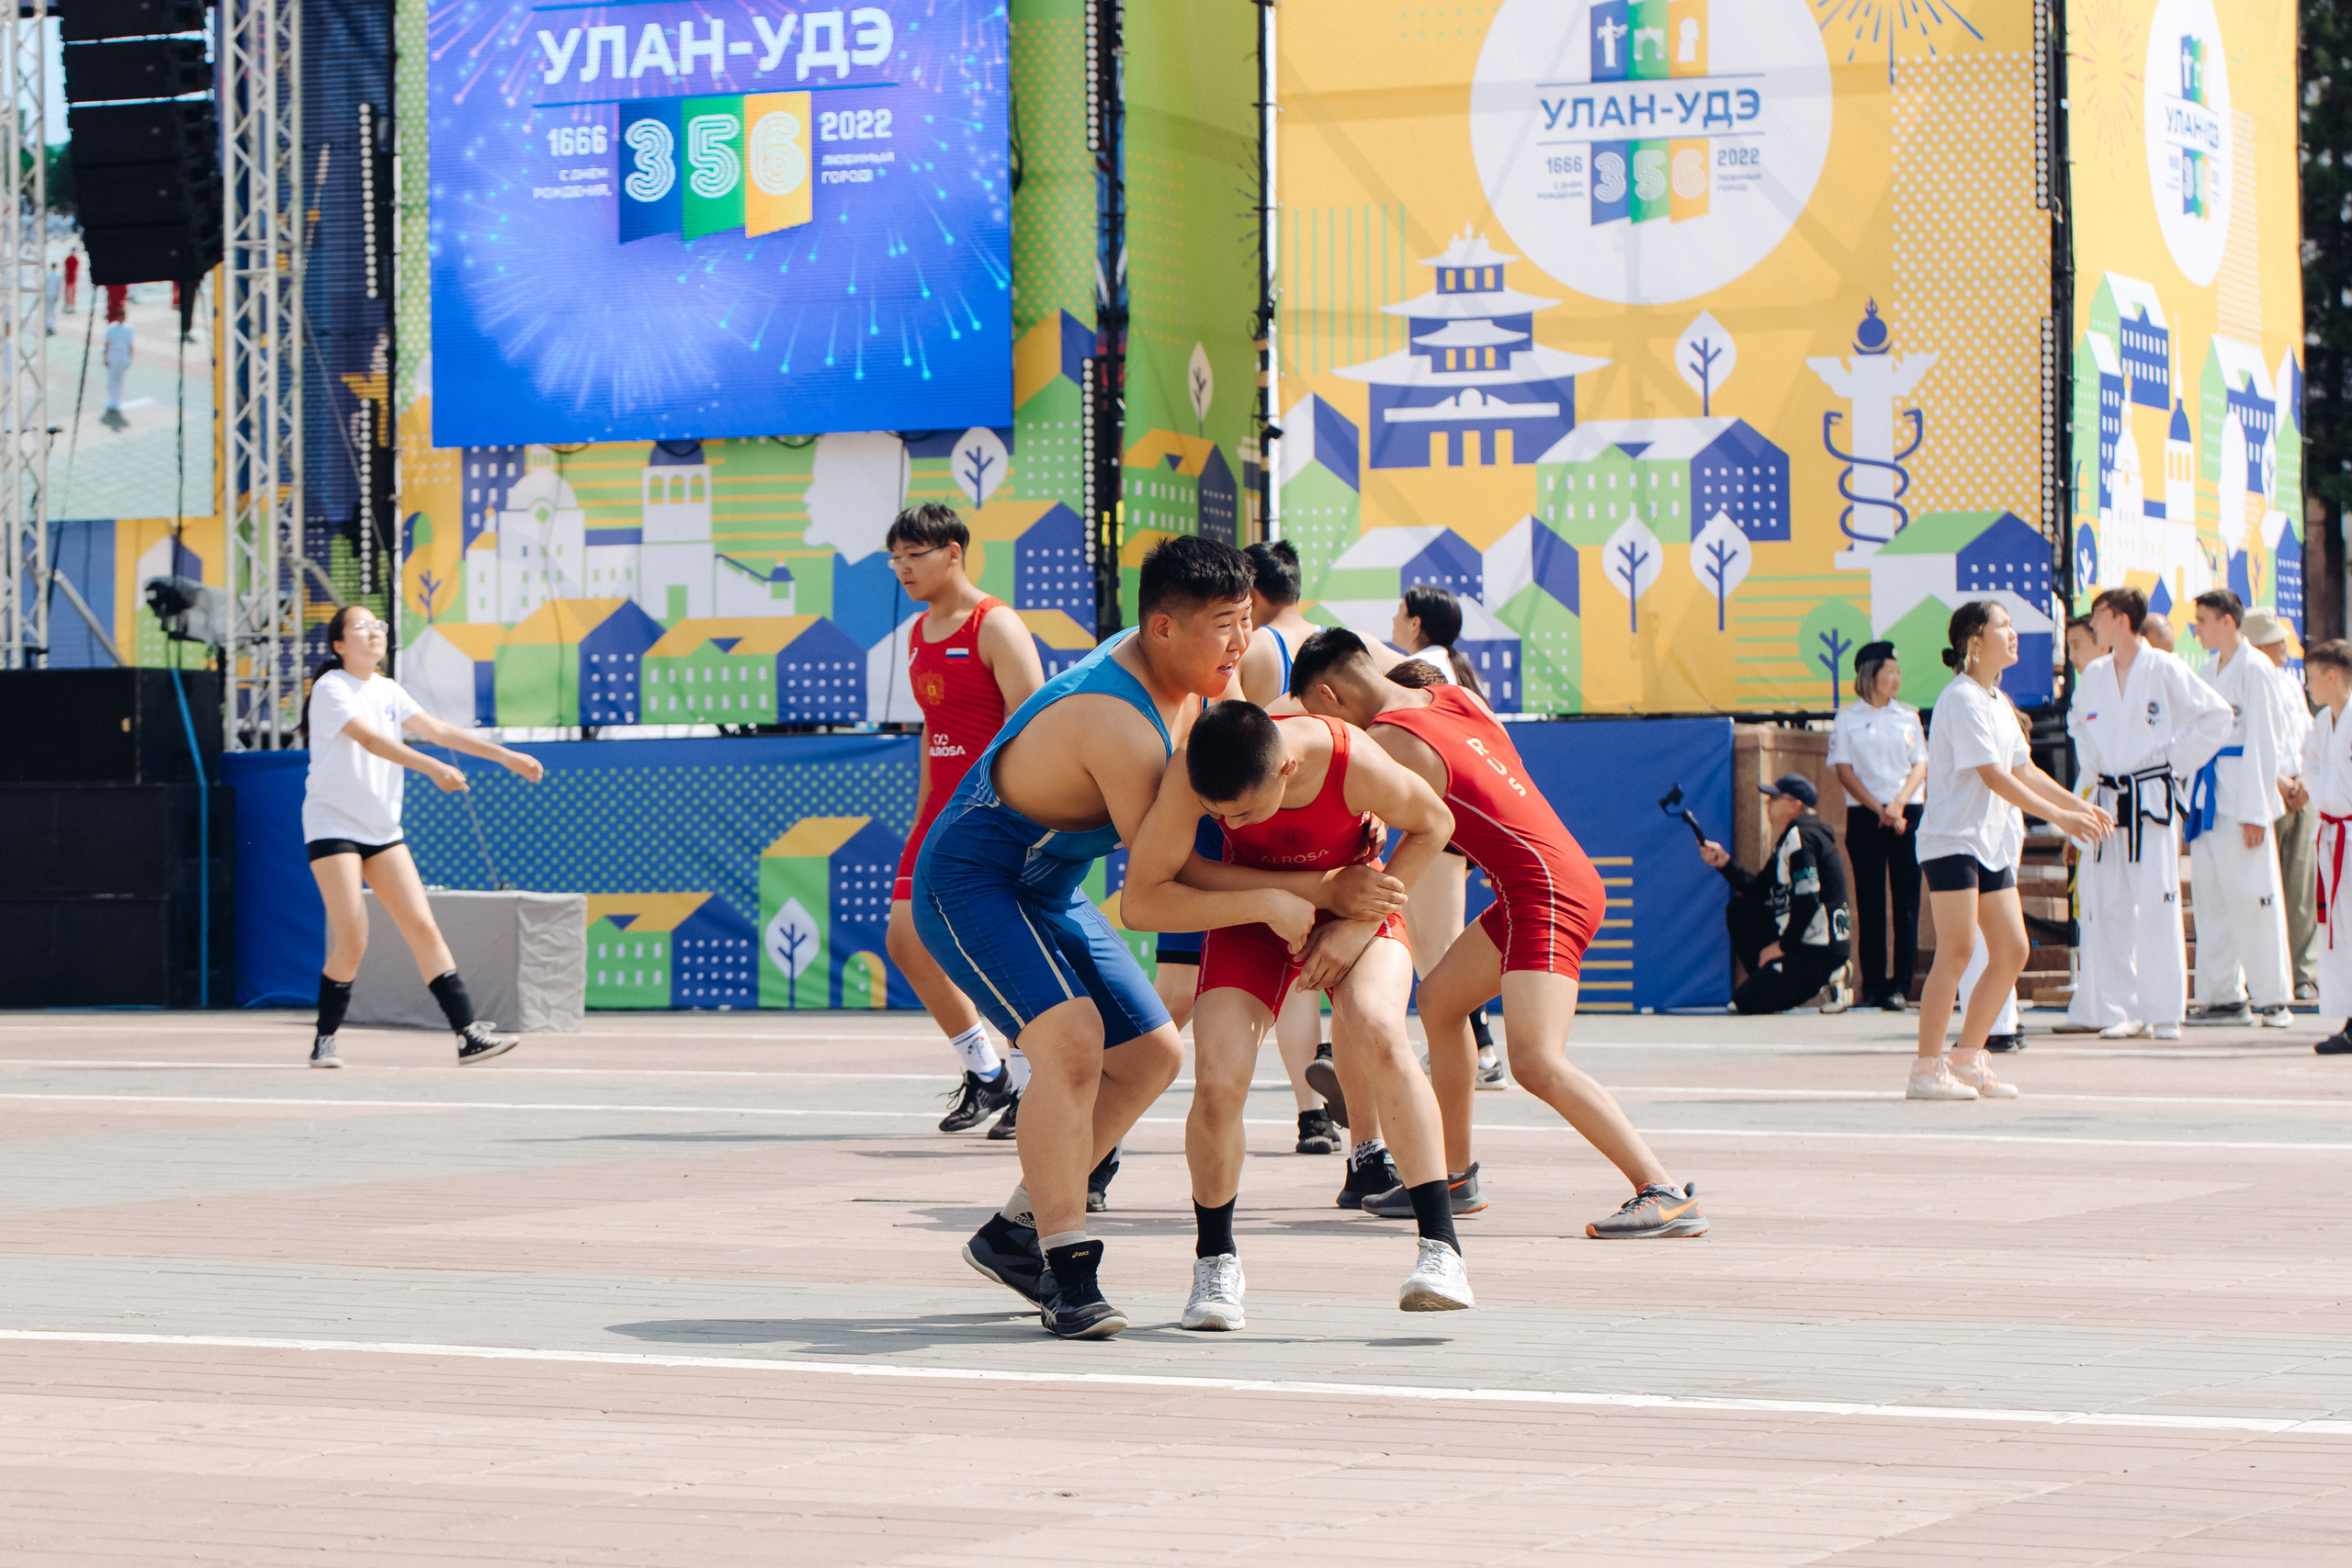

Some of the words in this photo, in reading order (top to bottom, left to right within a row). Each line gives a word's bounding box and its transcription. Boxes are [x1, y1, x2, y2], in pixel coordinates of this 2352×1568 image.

[537, 6, 895, 85] УЛАН-УДЭ
[819, 108, 893, 141] 2022
[1540, 88, 1761, 130] УЛАН-УДЭ
[546, 125, 608, 157] 1666
[625, 111, 808, 202] 356
[1717, 147, 1760, 166] 2022
[1546, 155, 1583, 174] 1666
[1593, 148, 1707, 204] 356
[1466, 738, 1526, 797] RUS
[1261, 849, 1329, 863] ALROSA
